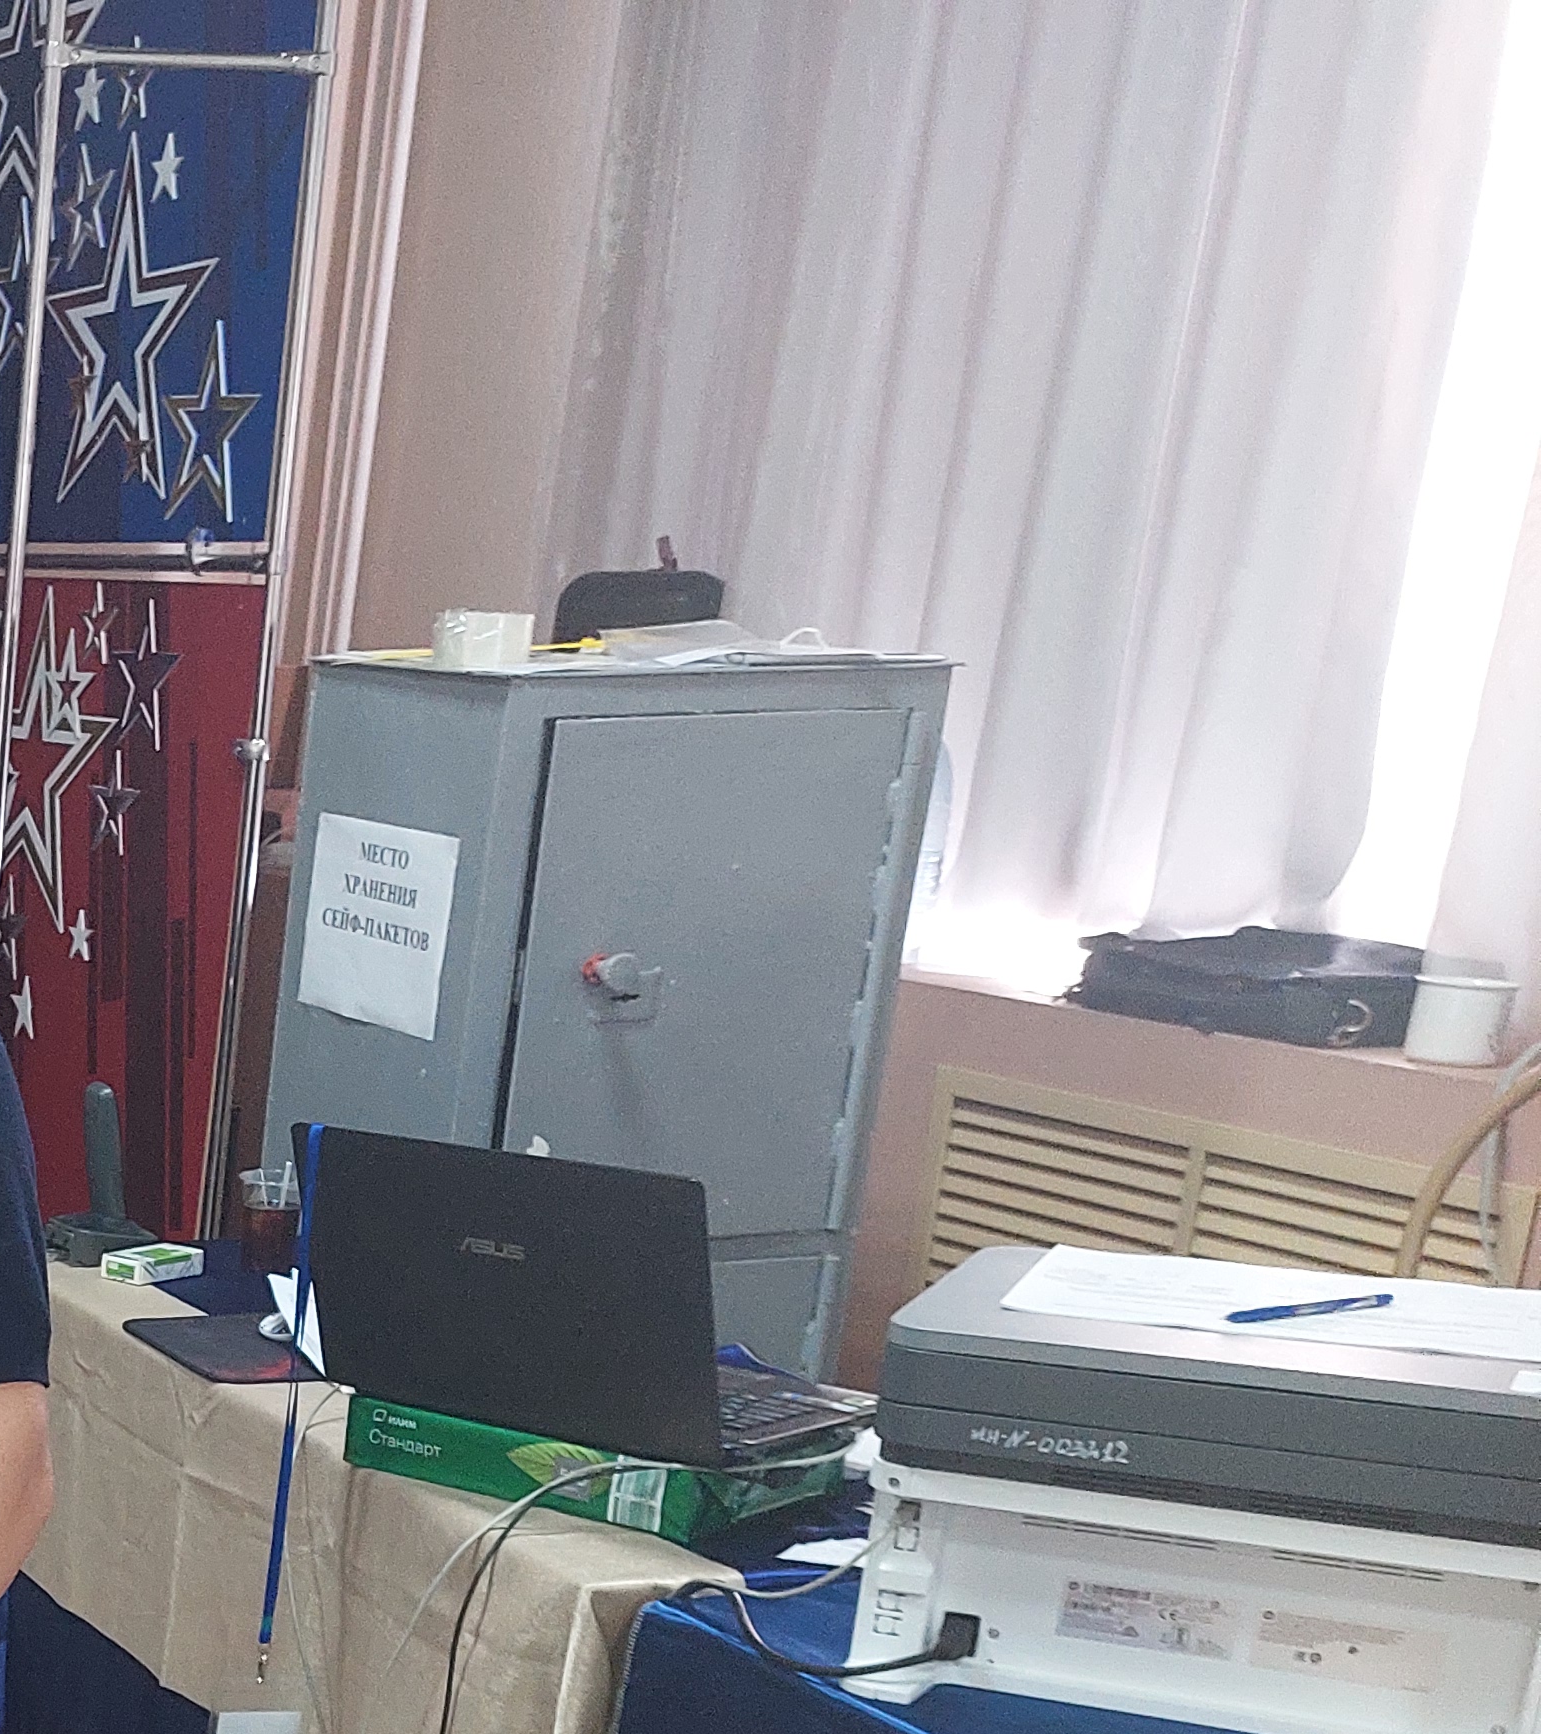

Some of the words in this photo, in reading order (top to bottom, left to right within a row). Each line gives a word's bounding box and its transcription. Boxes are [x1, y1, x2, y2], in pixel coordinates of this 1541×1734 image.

[360, 842, 409, 870] МЕСТО
[343, 873, 418, 909] ХРАНЕНИЯ
[322, 907, 430, 951] СЕЙФ-ПАКЕТОВ
[461, 1237, 525, 1260] ASUS
[368, 1428, 443, 1459] Стандарт
